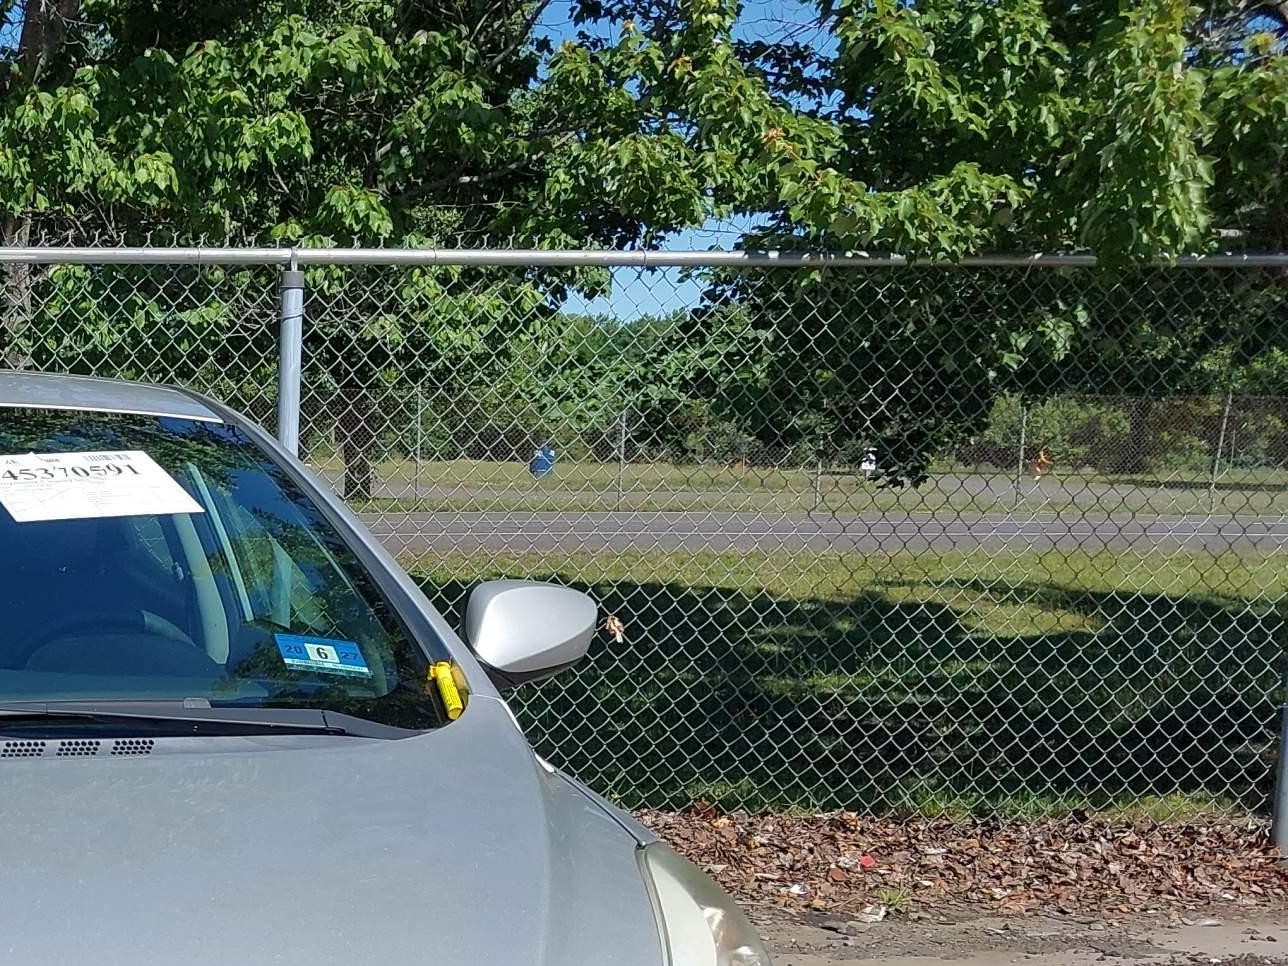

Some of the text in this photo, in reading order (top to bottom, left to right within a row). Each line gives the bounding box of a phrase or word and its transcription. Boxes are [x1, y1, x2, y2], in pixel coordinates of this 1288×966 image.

[2, 463, 144, 481] 45370591
[284, 644, 359, 661] 20 6 27
